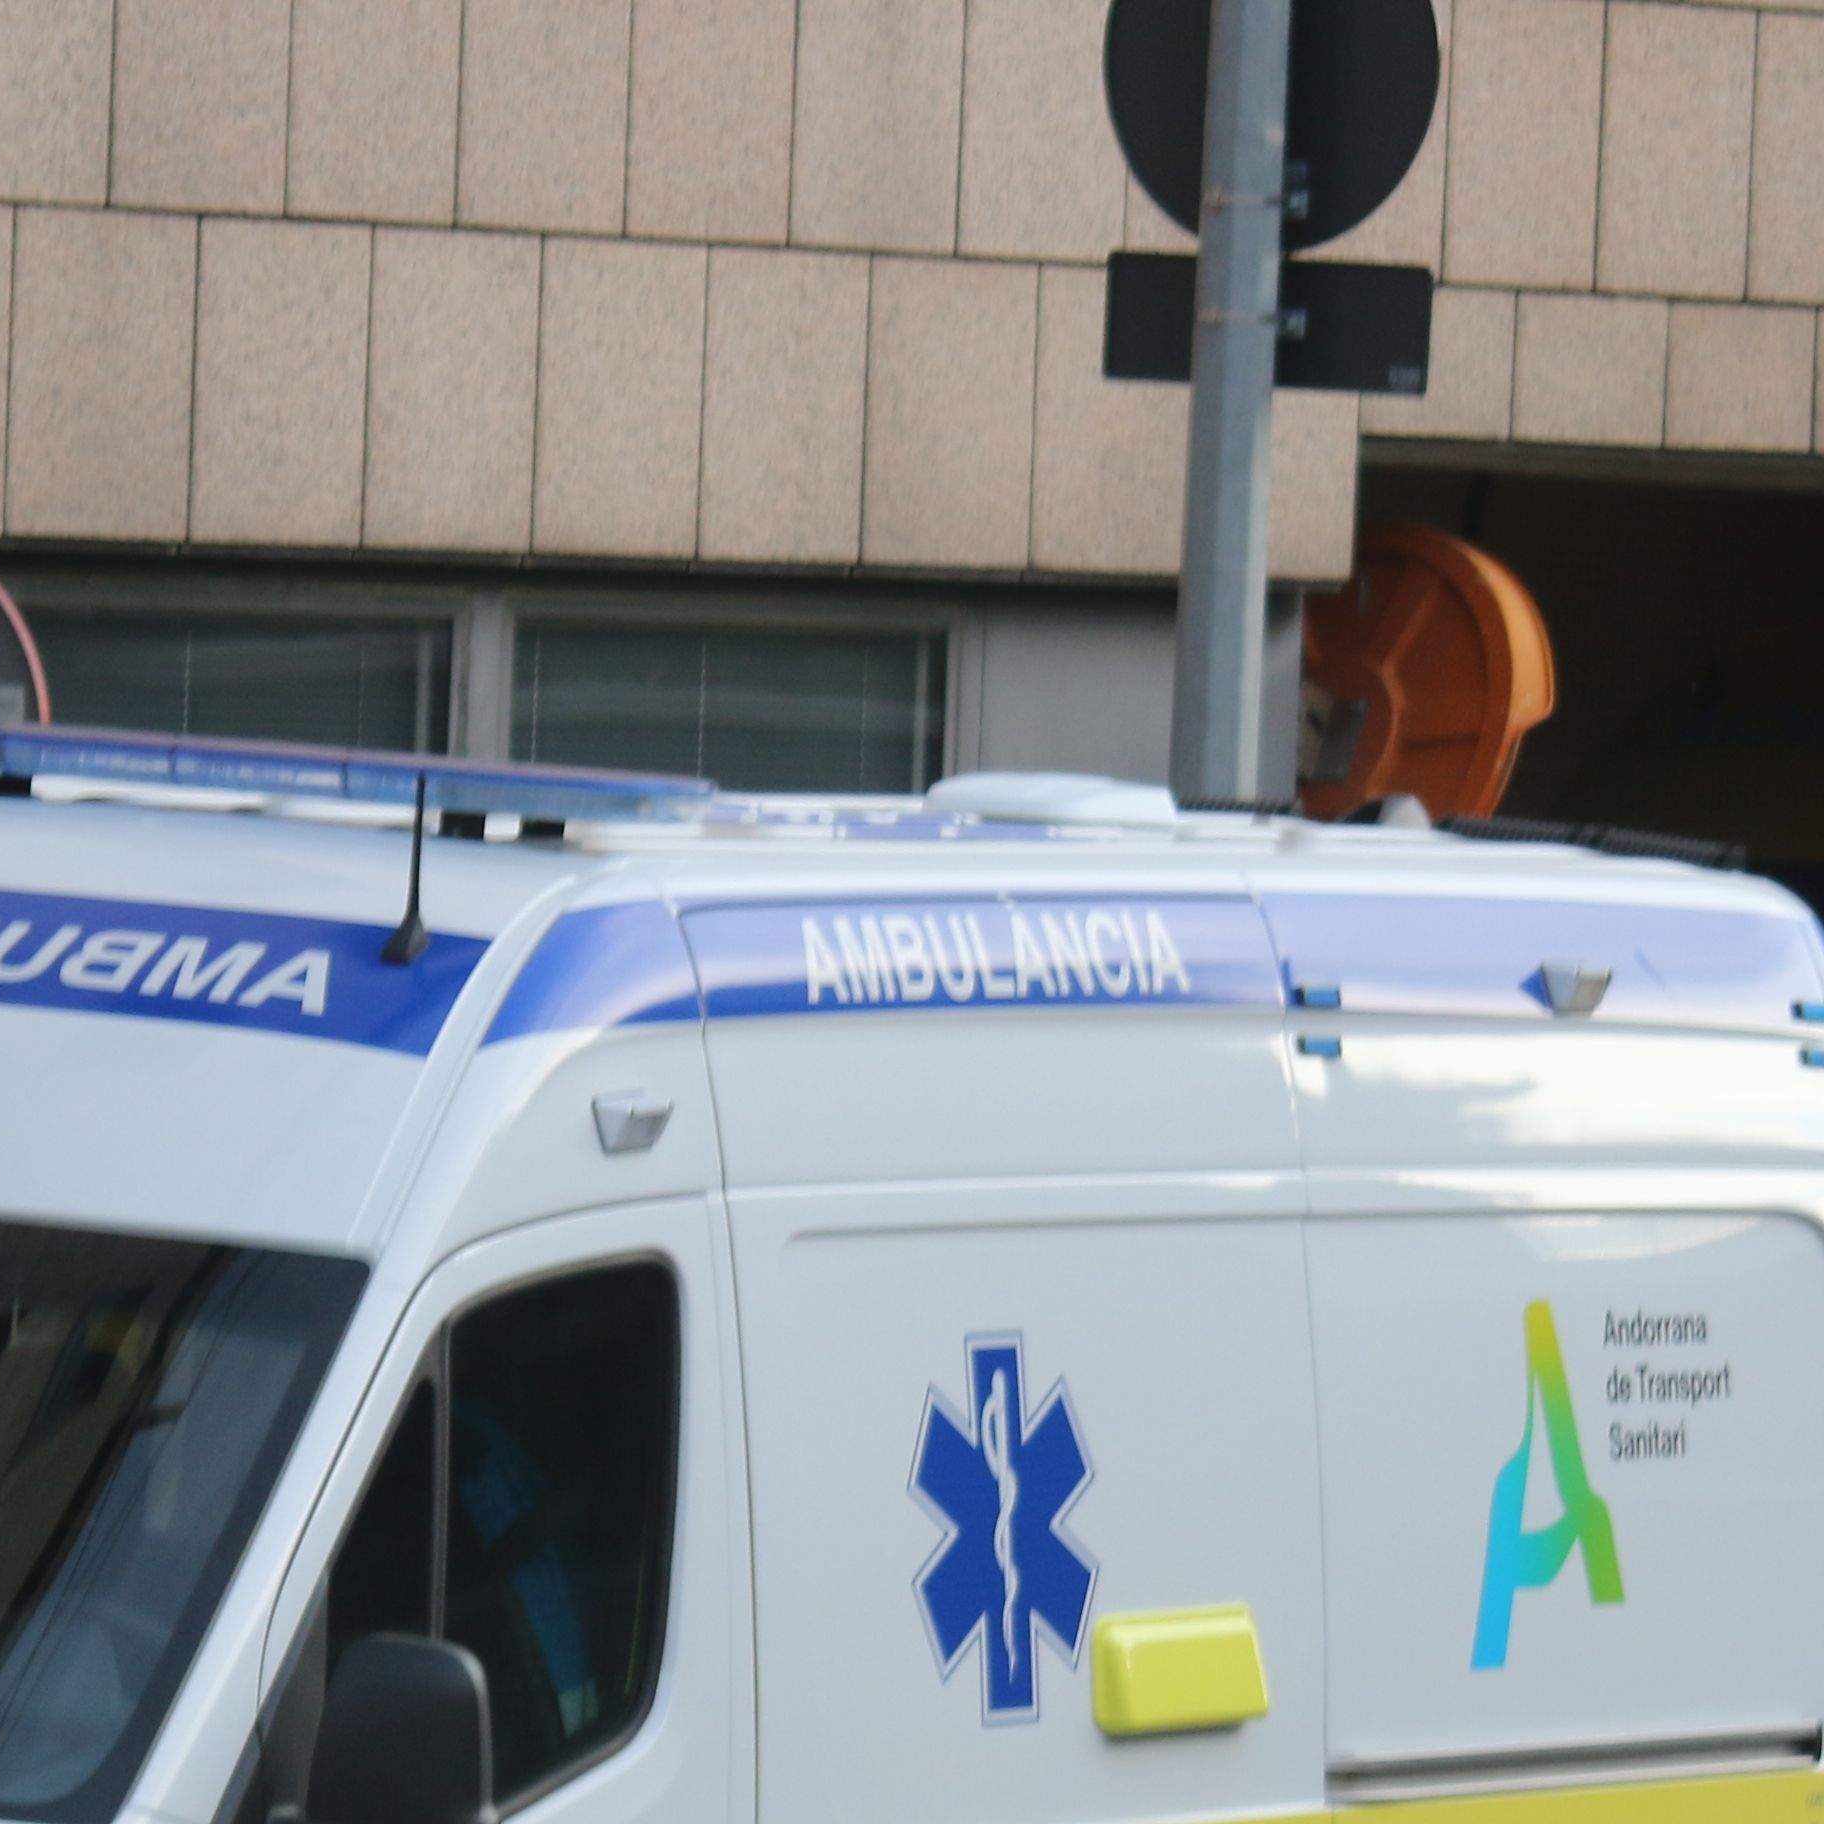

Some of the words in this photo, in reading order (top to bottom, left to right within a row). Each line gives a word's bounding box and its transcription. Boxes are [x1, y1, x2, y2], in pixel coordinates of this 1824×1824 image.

[1603, 1306, 1707, 1347] Andorrana
[1607, 1364, 1631, 1402] de
[1635, 1360, 1730, 1409] Transport
[1609, 1418, 1685, 1461] Sanitari
